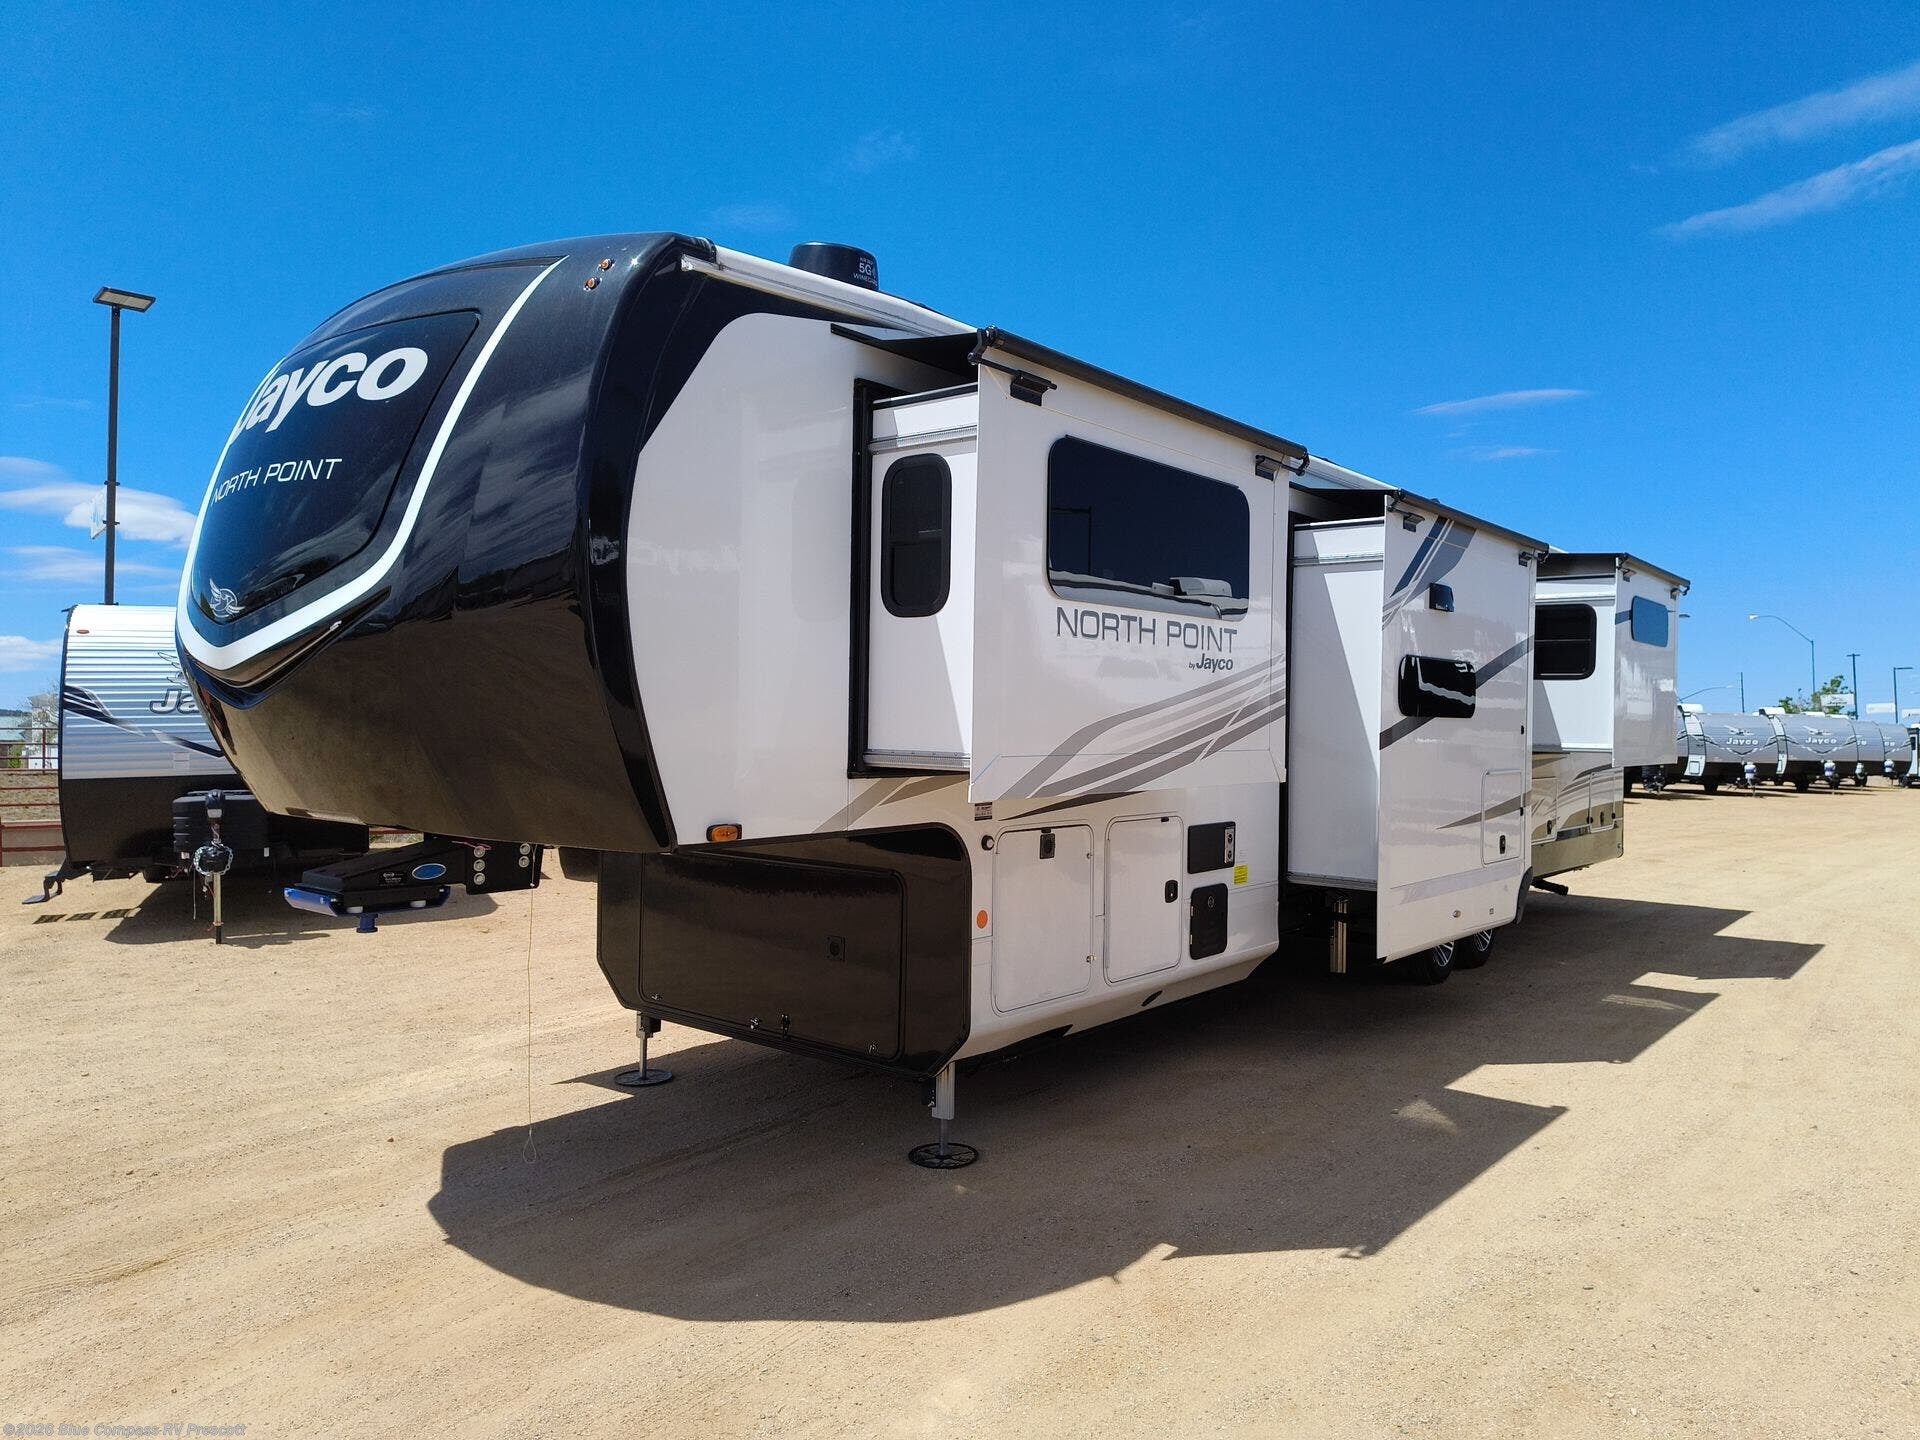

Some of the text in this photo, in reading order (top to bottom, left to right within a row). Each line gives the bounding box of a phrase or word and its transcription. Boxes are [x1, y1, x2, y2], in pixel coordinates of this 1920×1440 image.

[859, 263, 872, 276] 5G
[230, 347, 428, 445] Jayco
[211, 458, 342, 506] NORTH POINT
[1056, 606, 1238, 653] NORTH POINT
[1189, 653, 1234, 673] by Jayco
[149, 688, 200, 714] Ja
[1726, 737, 1759, 746] Jayco
[1805, 737, 1837, 745] Jayco
